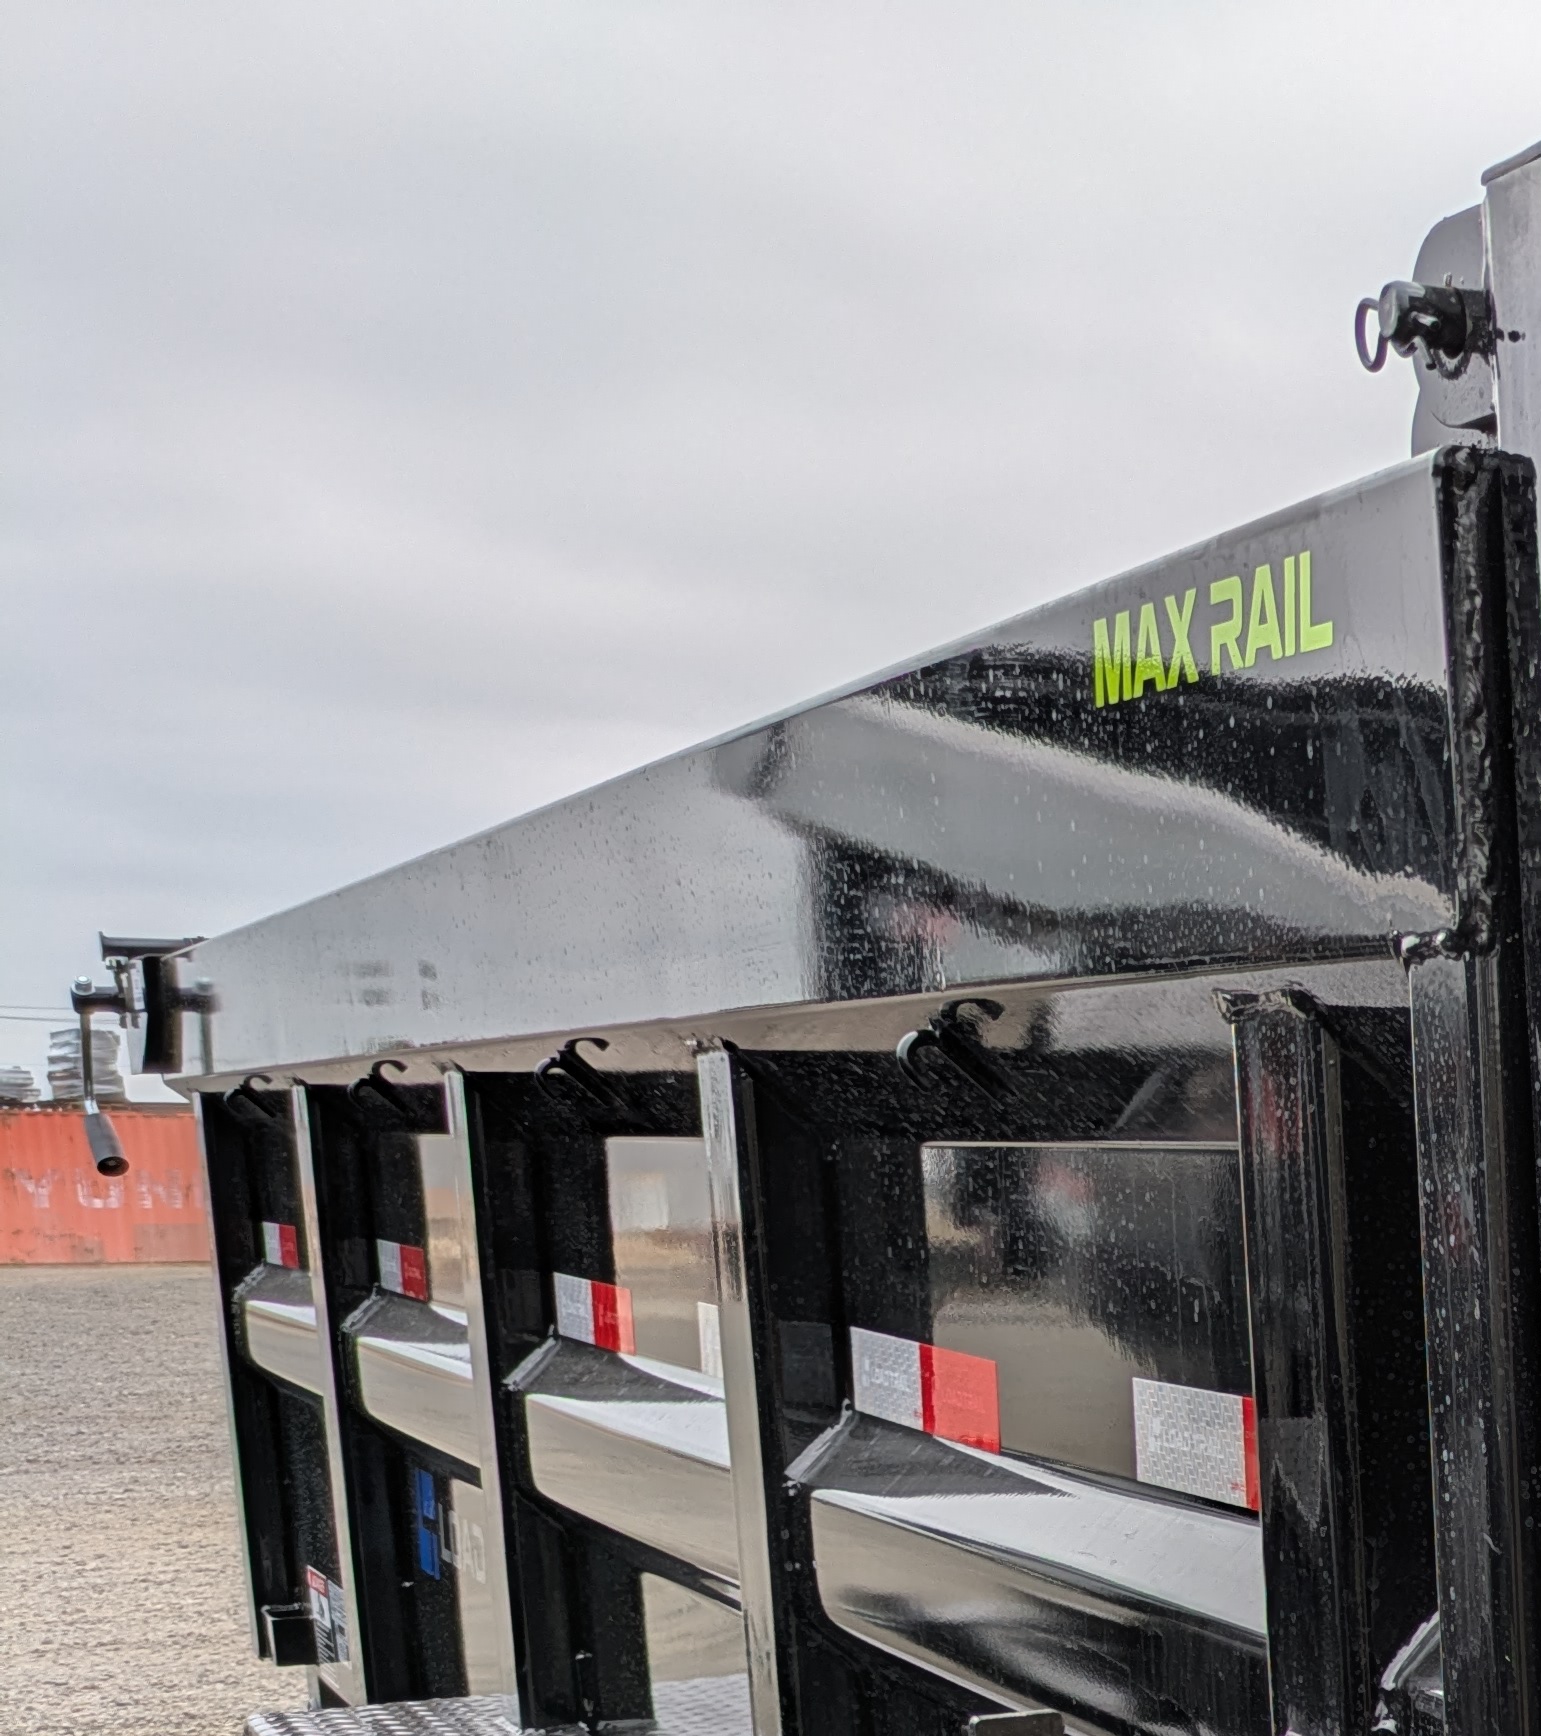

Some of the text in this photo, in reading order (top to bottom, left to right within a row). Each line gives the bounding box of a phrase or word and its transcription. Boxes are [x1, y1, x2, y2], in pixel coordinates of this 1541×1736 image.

[1093, 550, 1333, 708] MAX RAIL
[11, 1167, 203, 1210] YUN
